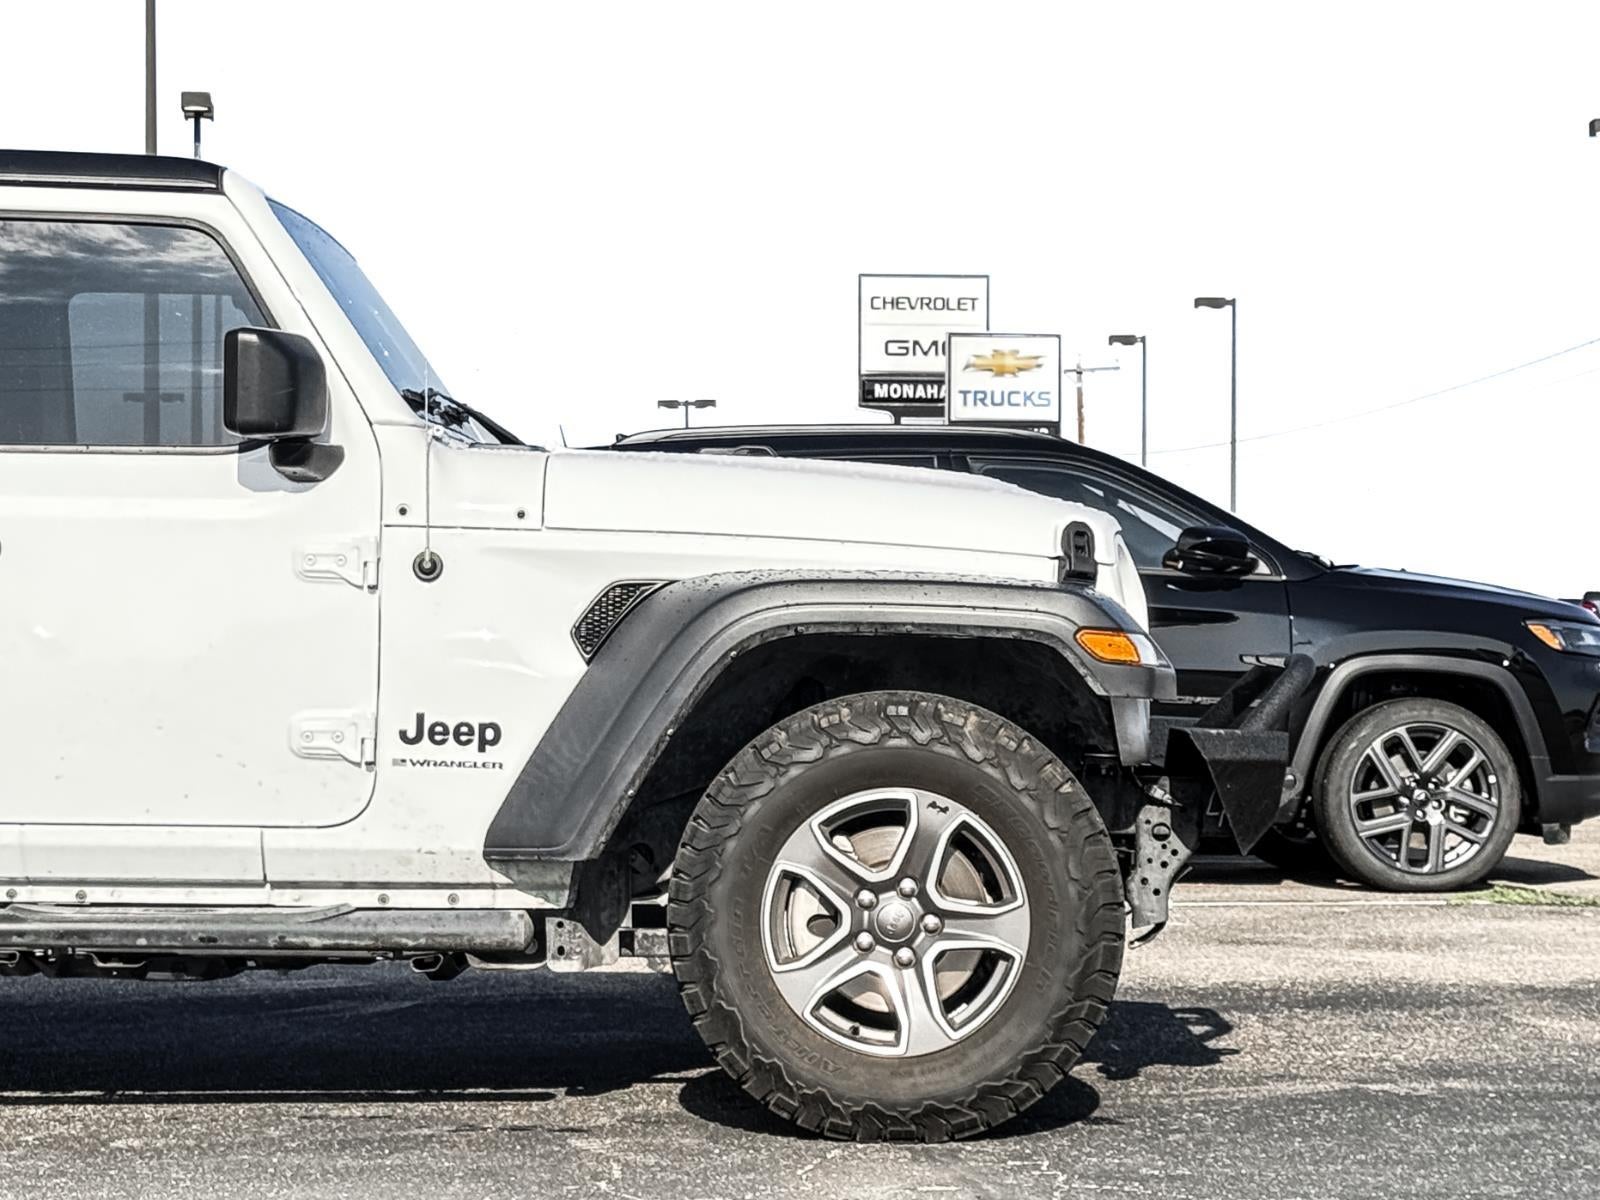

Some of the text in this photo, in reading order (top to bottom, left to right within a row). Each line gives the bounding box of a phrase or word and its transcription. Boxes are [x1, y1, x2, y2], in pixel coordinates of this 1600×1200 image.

[870, 296, 979, 312] CHEVROLET
[885, 339, 946, 356] GM
[958, 390, 1052, 407] TRUCKS
[399, 712, 502, 753] Jeep
[409, 758, 504, 770] WRANGLER
